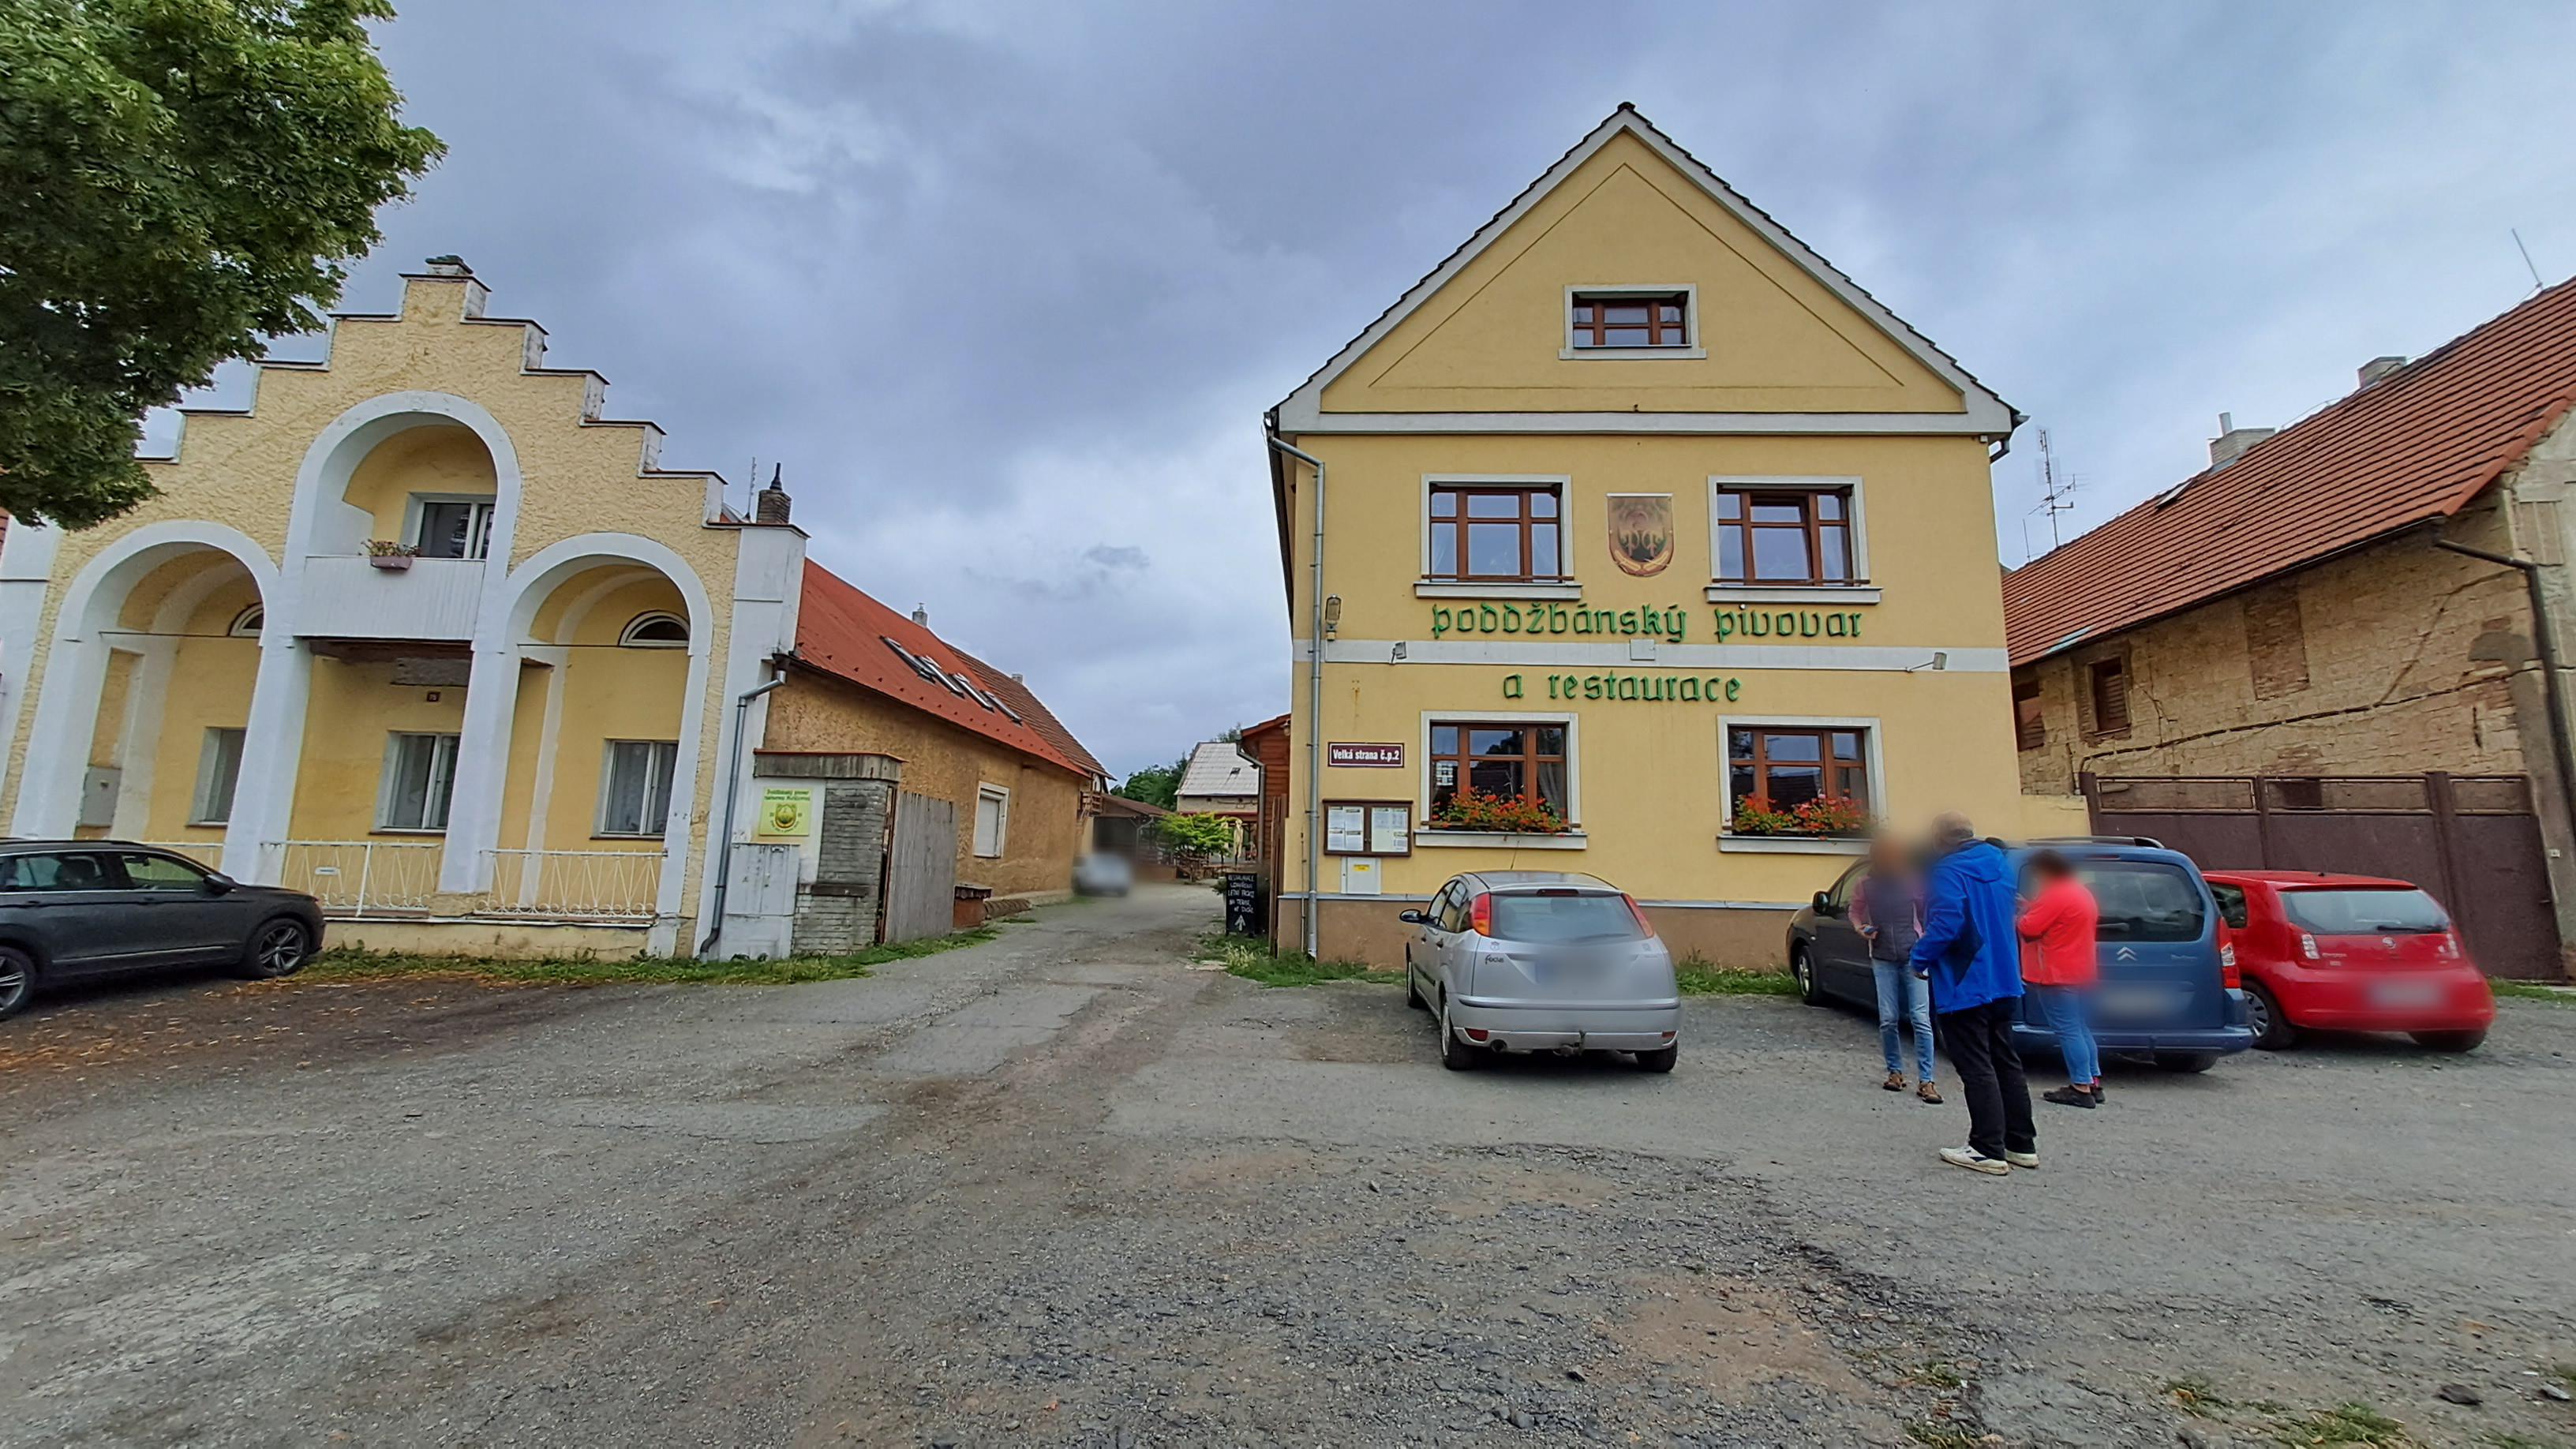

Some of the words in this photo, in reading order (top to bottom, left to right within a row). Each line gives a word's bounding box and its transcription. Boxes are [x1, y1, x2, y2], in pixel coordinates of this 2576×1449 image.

[1432, 603, 1687, 642] poddžbánský
[1714, 604, 1863, 642] pivovar
[1503, 673, 1523, 700] a
[1548, 670, 1741, 702] restaurace
[1333, 749, 1353, 760] Velká
[1355, 750, 1378, 760] strana
[1380, 750, 1399, 762] č.p.2
